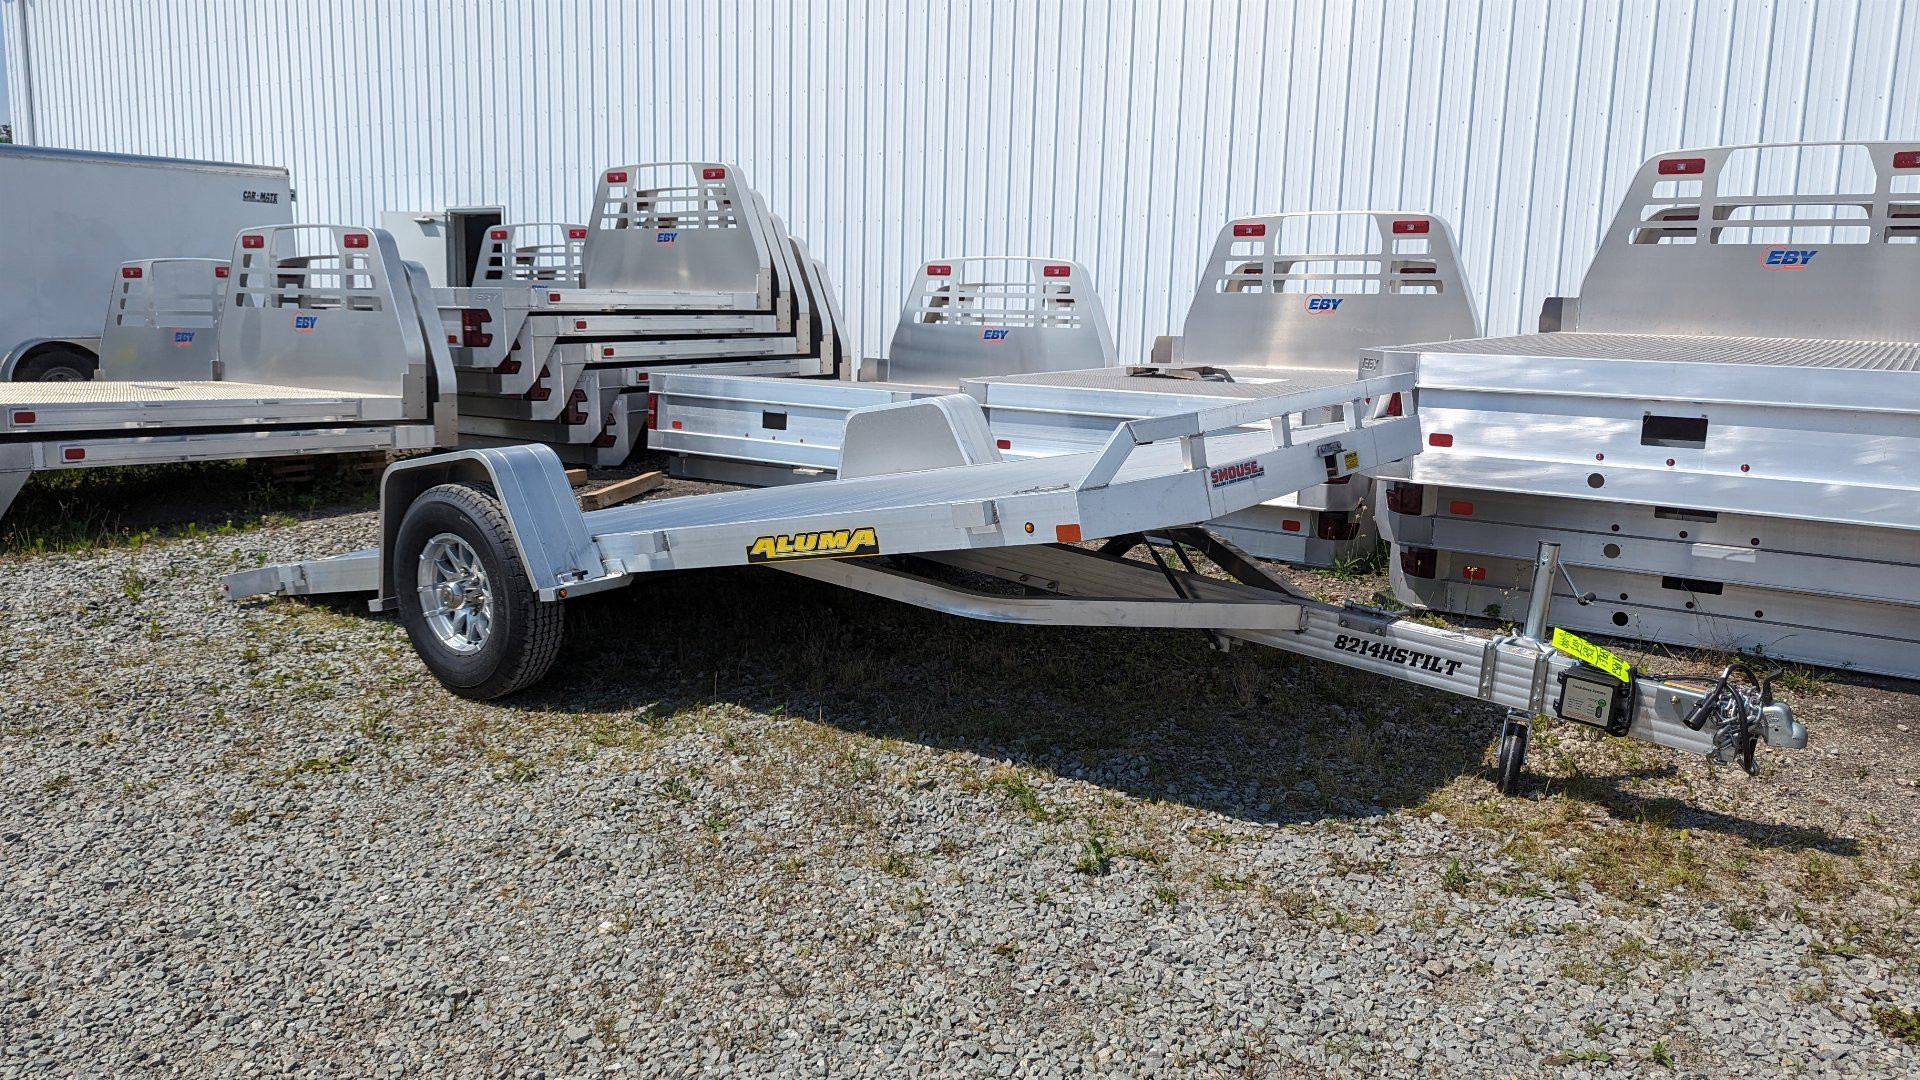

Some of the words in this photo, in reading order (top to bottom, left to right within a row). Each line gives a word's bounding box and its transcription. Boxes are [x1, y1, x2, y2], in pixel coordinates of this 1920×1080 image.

[656, 232, 678, 243] EBY
[1765, 250, 1819, 265] EBY
[1308, 298, 1344, 310] EBY
[294, 316, 317, 328] EBY
[175, 332, 195, 342] EBY
[984, 329, 1009, 340] EBY
[1361, 357, 1380, 371] EBY
[1211, 460, 1258, 484] SMOUSE
[749, 527, 876, 559] ALUMA
[1334, 634, 1462, 676] 8214HSTILT
